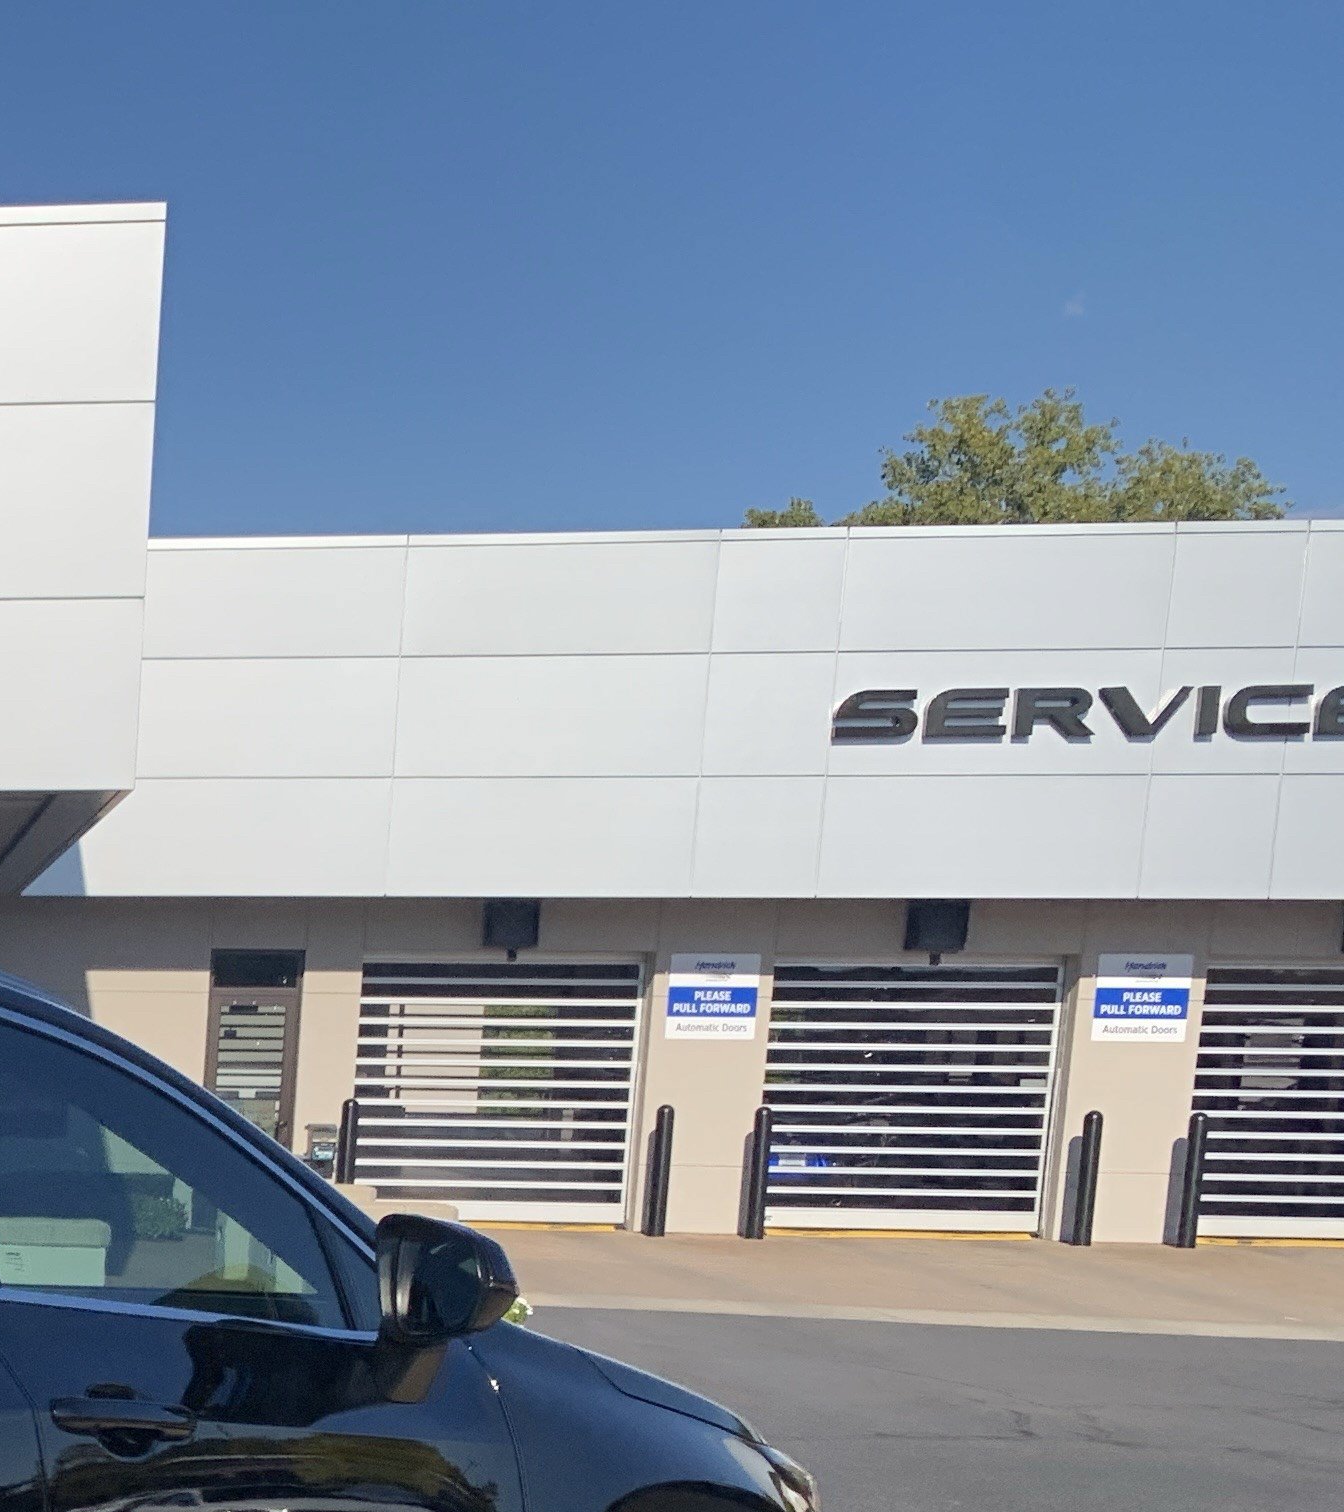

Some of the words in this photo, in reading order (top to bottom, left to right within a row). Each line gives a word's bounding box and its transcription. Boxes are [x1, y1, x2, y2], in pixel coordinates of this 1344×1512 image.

[694, 990, 732, 1001] PLEASE
[1122, 991, 1163, 1003] PLEASE
[672, 1002, 698, 1014] PULL
[699, 1003, 751, 1014] FORWARD
[1099, 1004, 1126, 1015] PULL
[1127, 1004, 1183, 1016] FORWARD
[675, 1023, 720, 1033] Automatic
[721, 1023, 748, 1033] Doors
[1102, 1025, 1149, 1034] Automatic
[1150, 1025, 1178, 1035] Doors
